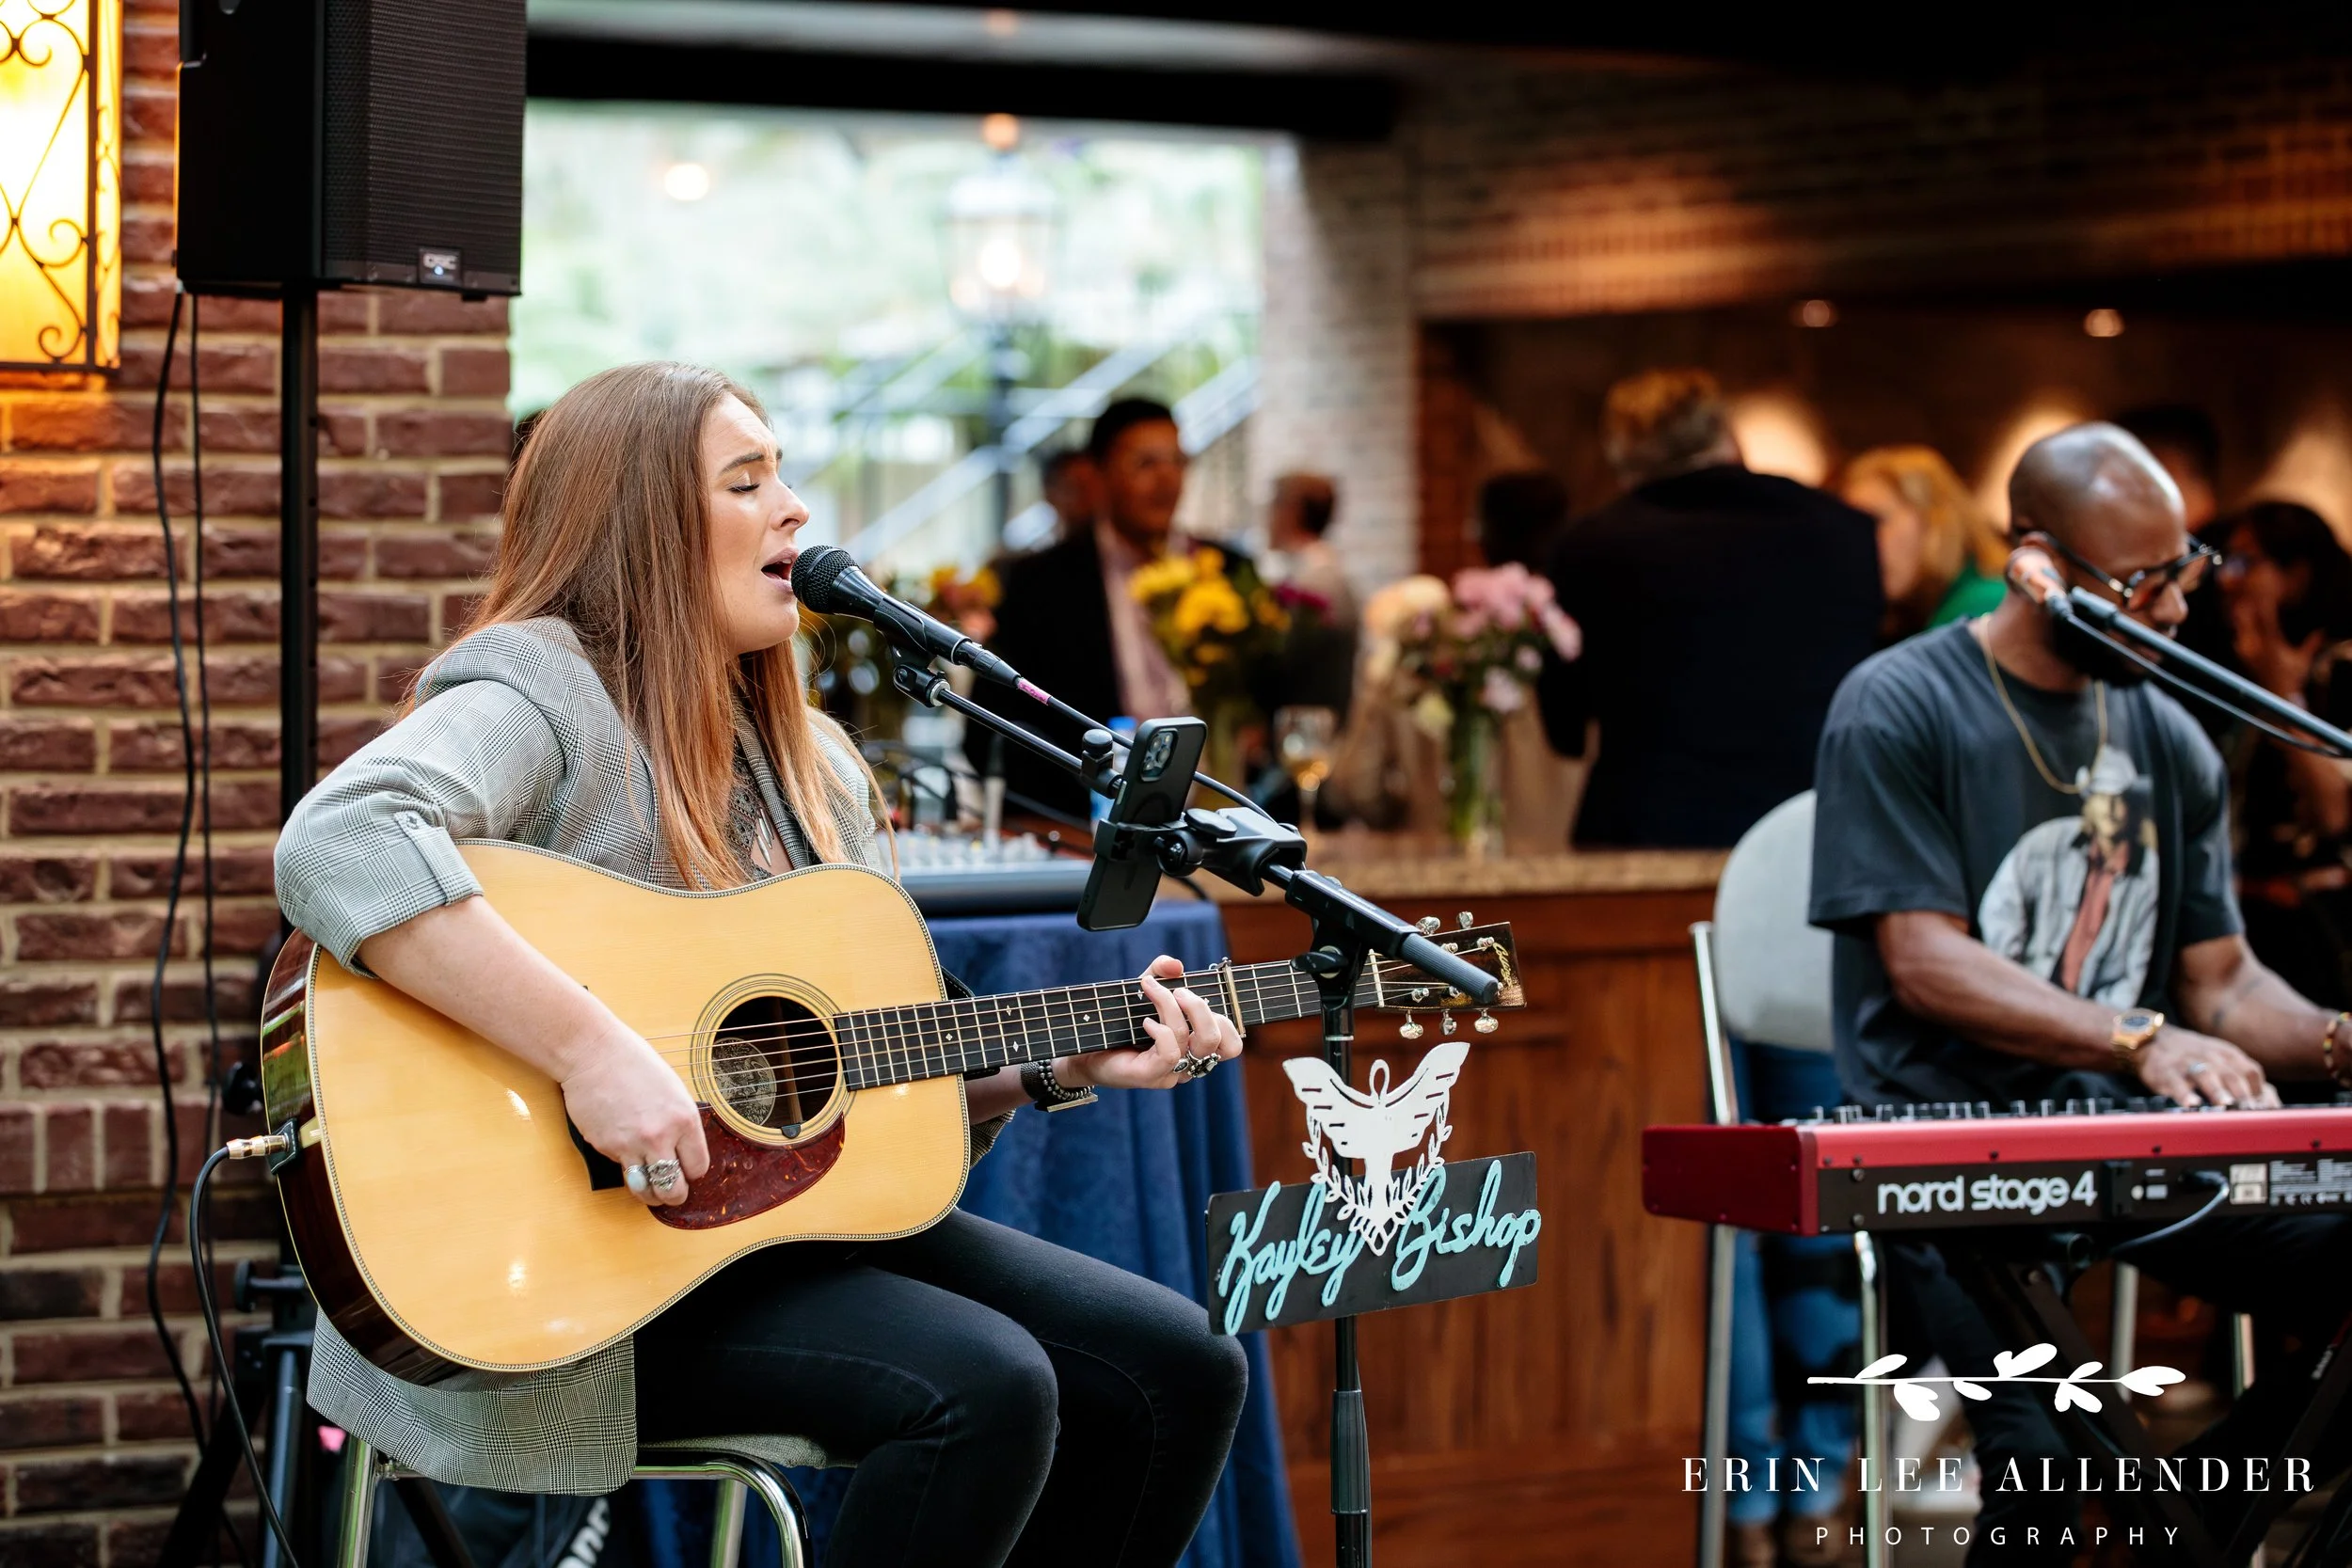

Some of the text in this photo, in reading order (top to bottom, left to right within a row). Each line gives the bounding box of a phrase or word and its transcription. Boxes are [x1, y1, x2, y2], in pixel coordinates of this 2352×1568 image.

[1217, 1160, 1542, 1338] Kayley Bishop
[1878, 1175, 1965, 1214] nord
[1970, 1174, 2071, 1216] stage
[2071, 1170, 2099, 1208] 4
